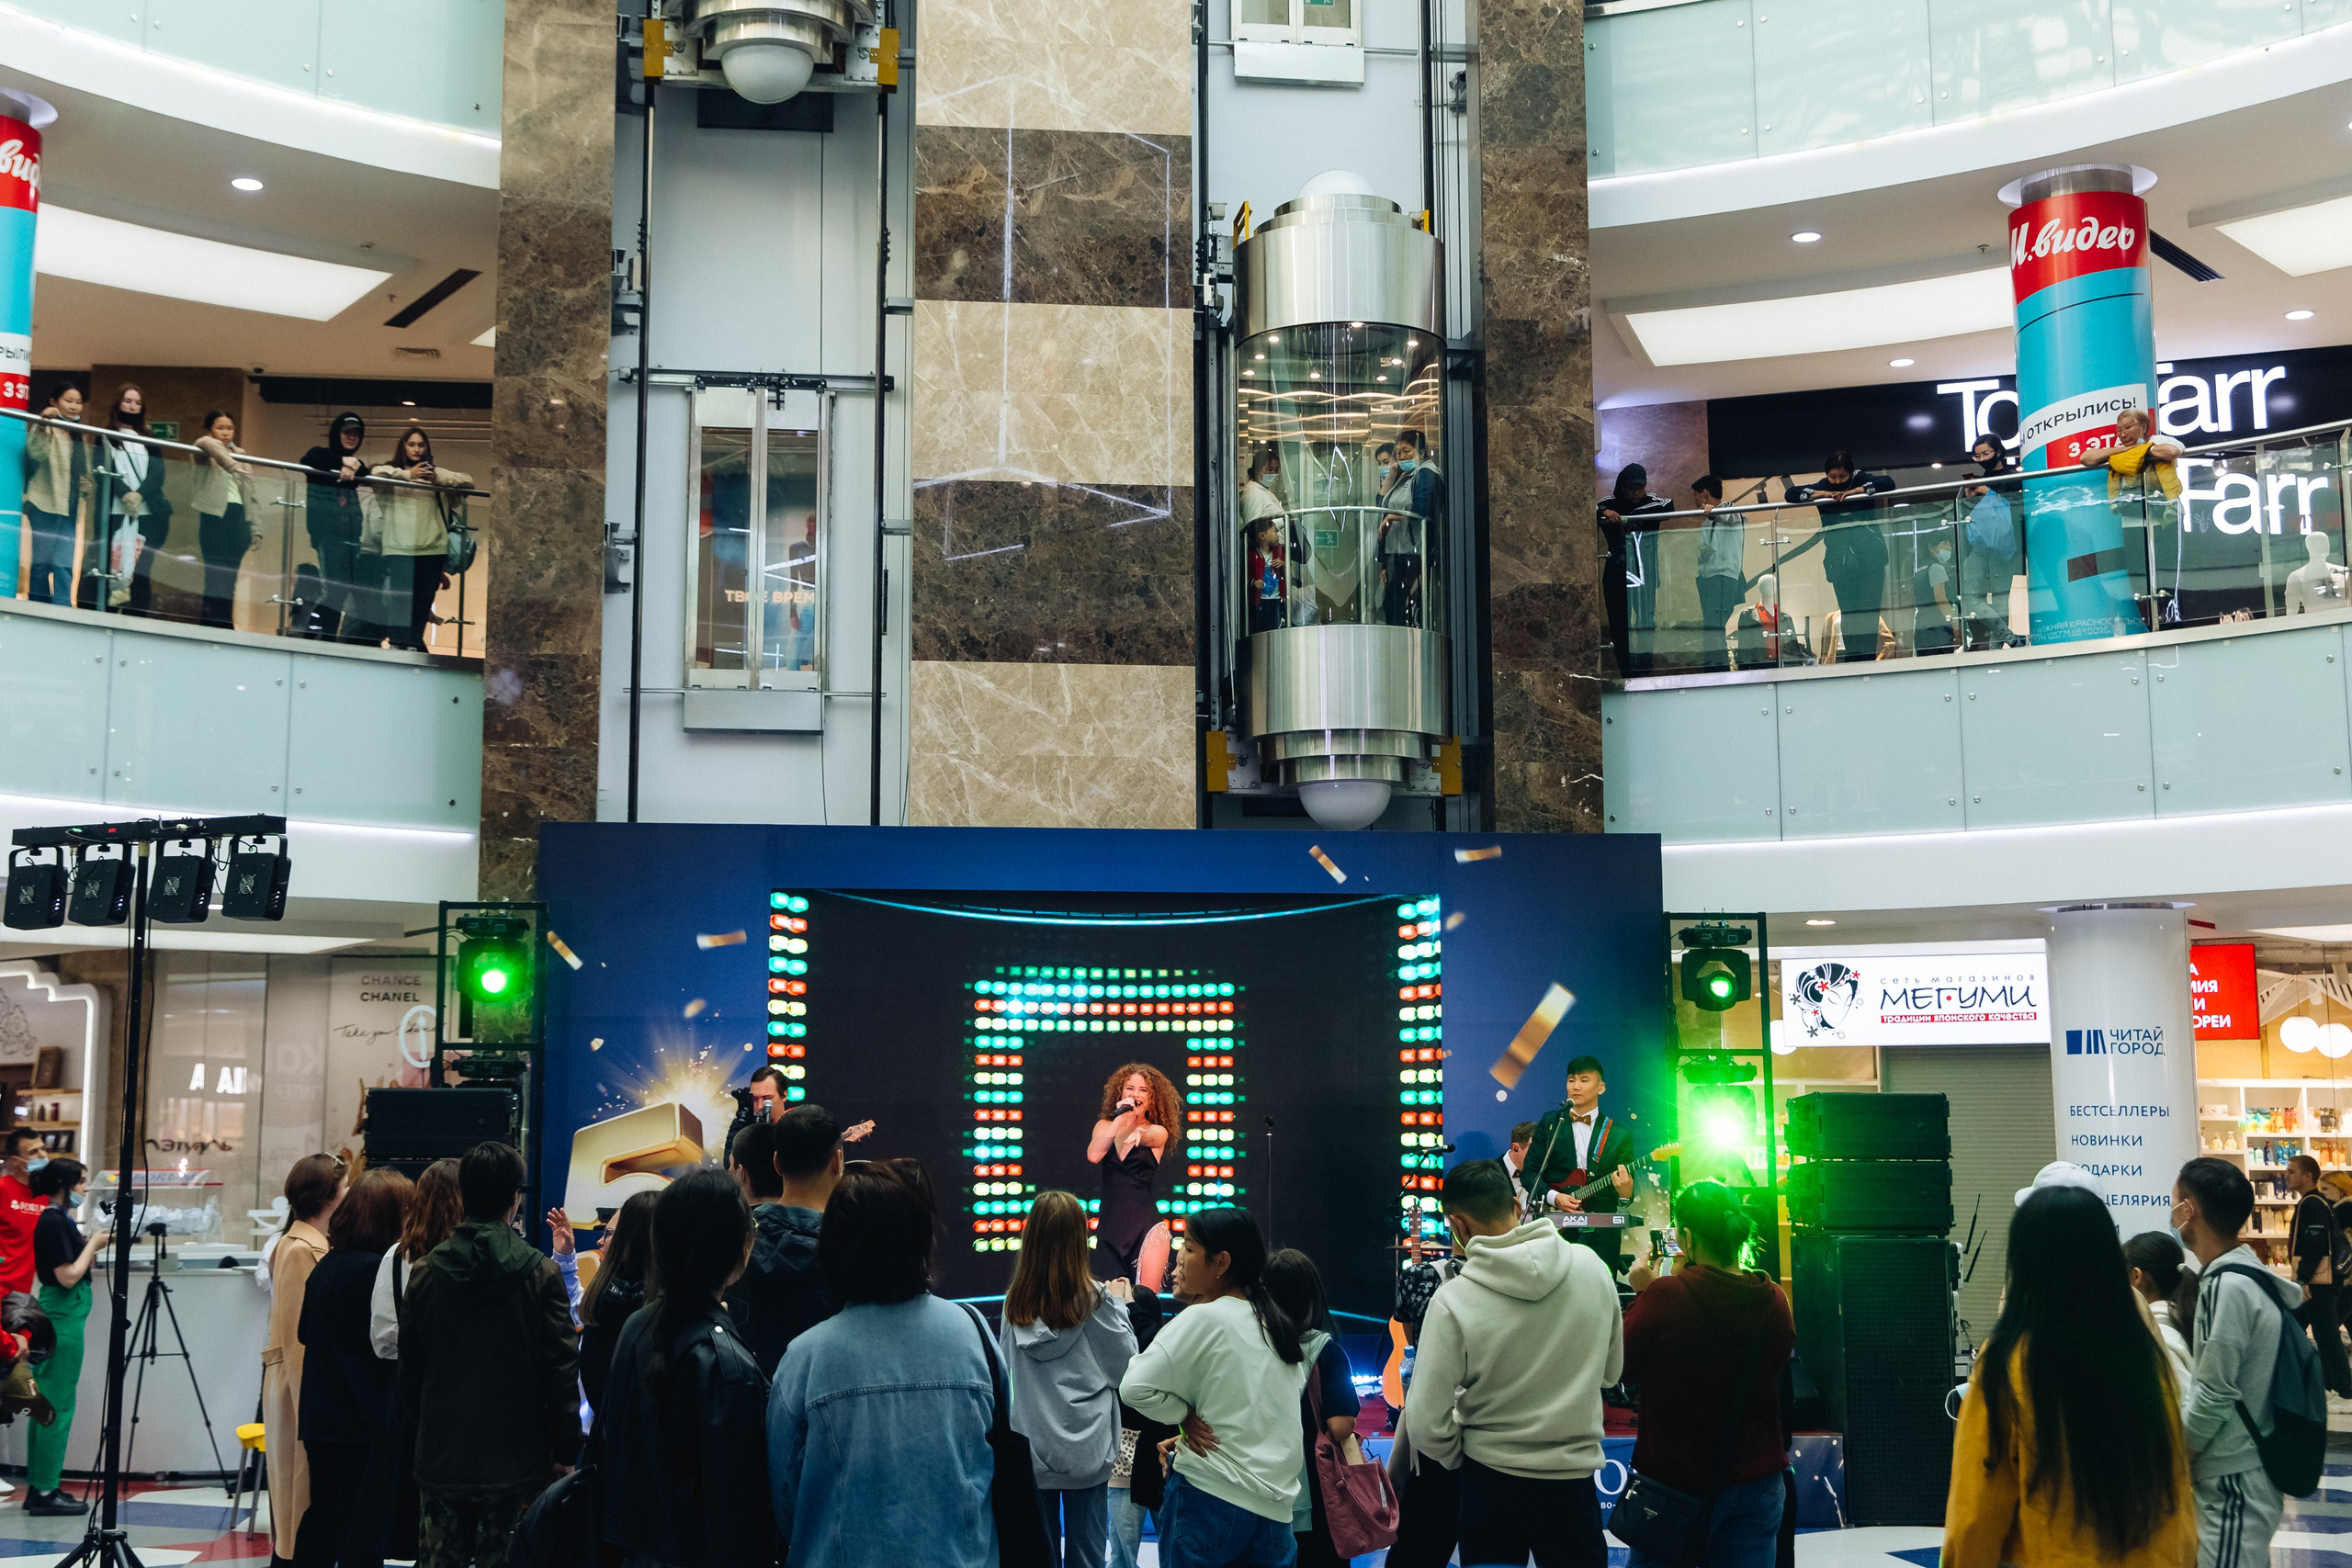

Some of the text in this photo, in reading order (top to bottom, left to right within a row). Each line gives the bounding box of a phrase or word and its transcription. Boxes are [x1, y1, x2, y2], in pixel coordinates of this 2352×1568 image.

[2156, 362, 2286, 436] arr
[2027, 397, 2137, 440] ОТКРЫЛИСЬ!
[360, 976, 421, 986] CHANCE
[1881, 974, 2034, 985] сеть магазинов
[359, 991, 420, 1002] CHANEL
[1881, 986, 2037, 1010] МЕГУМИ
[1883, 1011, 2035, 1023] традиции японского качества
[2109, 1026, 2164, 1041] ЧИТАЙ
[2110, 1043, 2165, 1056] ГОРОД
[2070, 1105, 2170, 1117] БЕСТСЕЛЛЕРЫ
[2071, 1134, 2143, 1146] НОВИНКИ
[2076, 1164, 2142, 1177] ОДАРКИ
[2103, 1194, 2171, 1207] ЦЕЛЯРИЯ
[1612, 1215, 1625, 1224] 61
